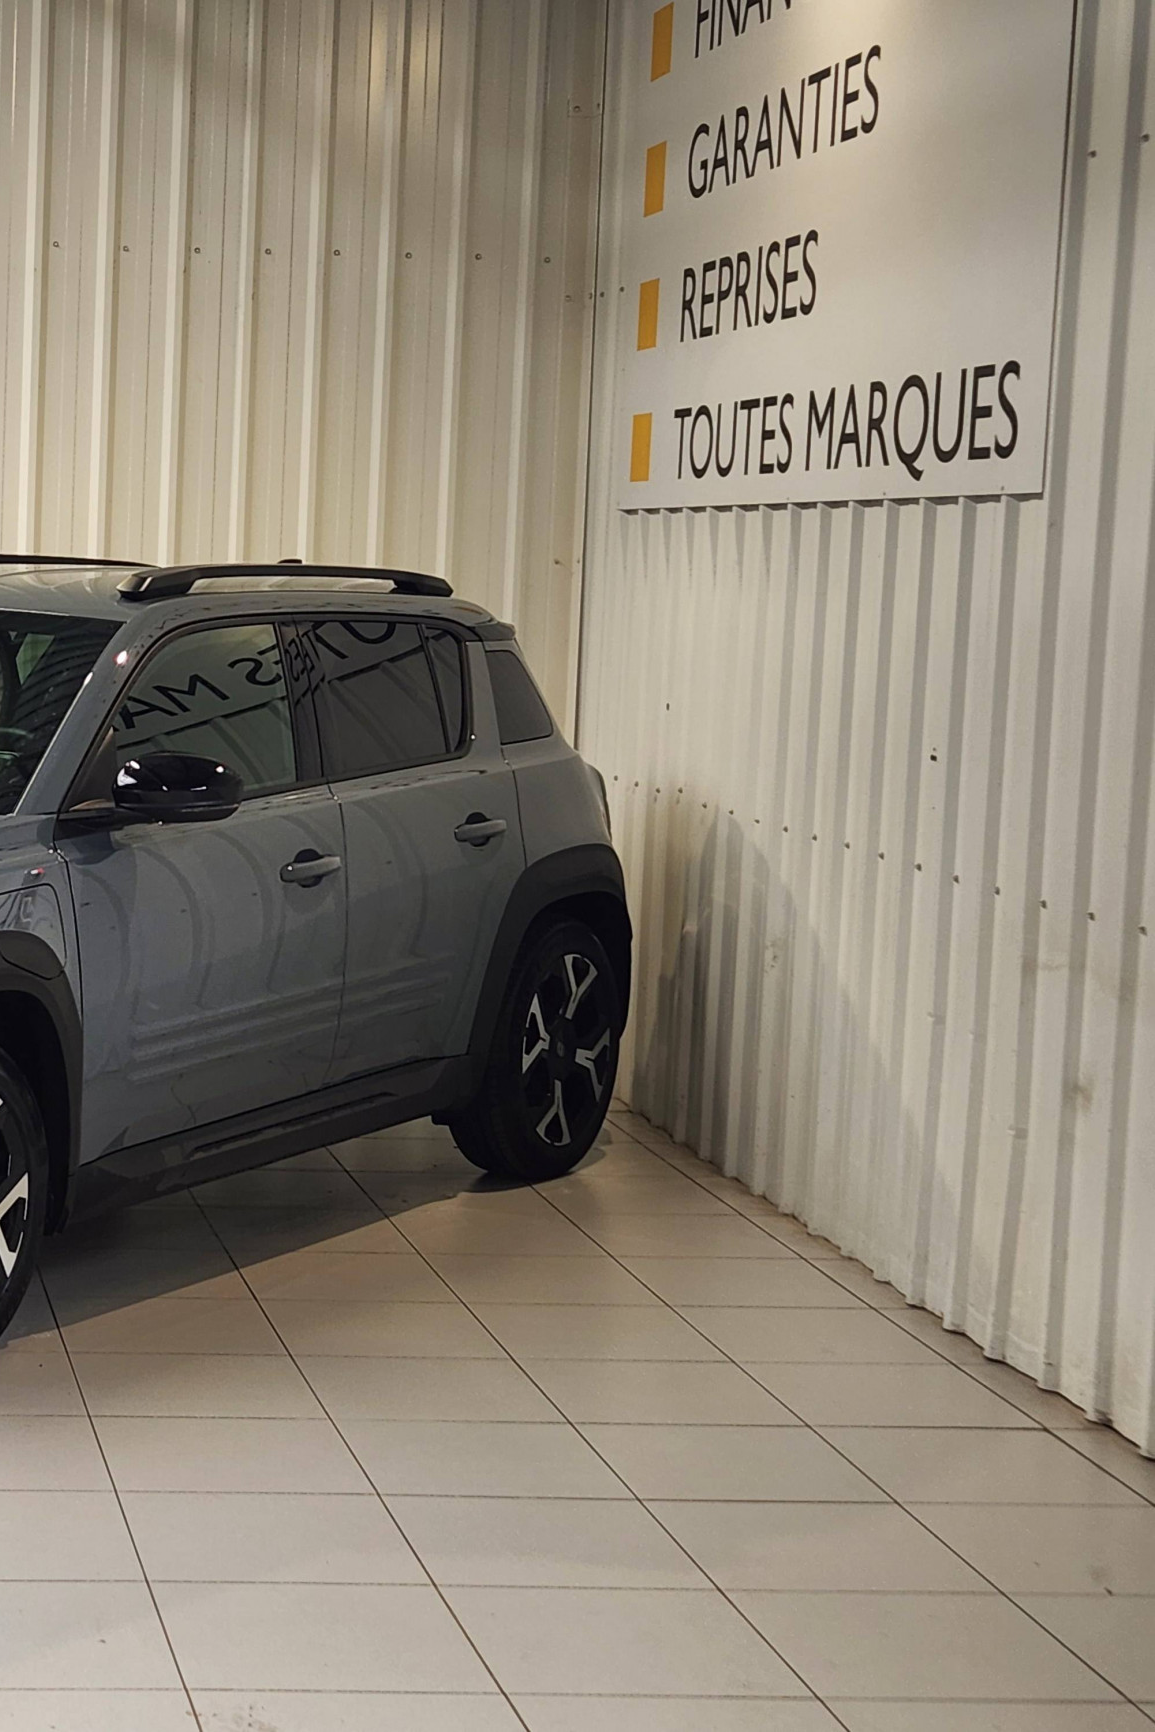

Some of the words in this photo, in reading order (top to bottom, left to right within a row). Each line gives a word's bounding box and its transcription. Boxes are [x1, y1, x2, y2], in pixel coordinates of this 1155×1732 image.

[694, 0, 791, 59] FIN
[688, 45, 882, 199] GARANTIES
[680, 229, 819, 343] REPRISES
[674, 393, 795, 480] TOUTES
[804, 360, 1022, 482] MARQUES
